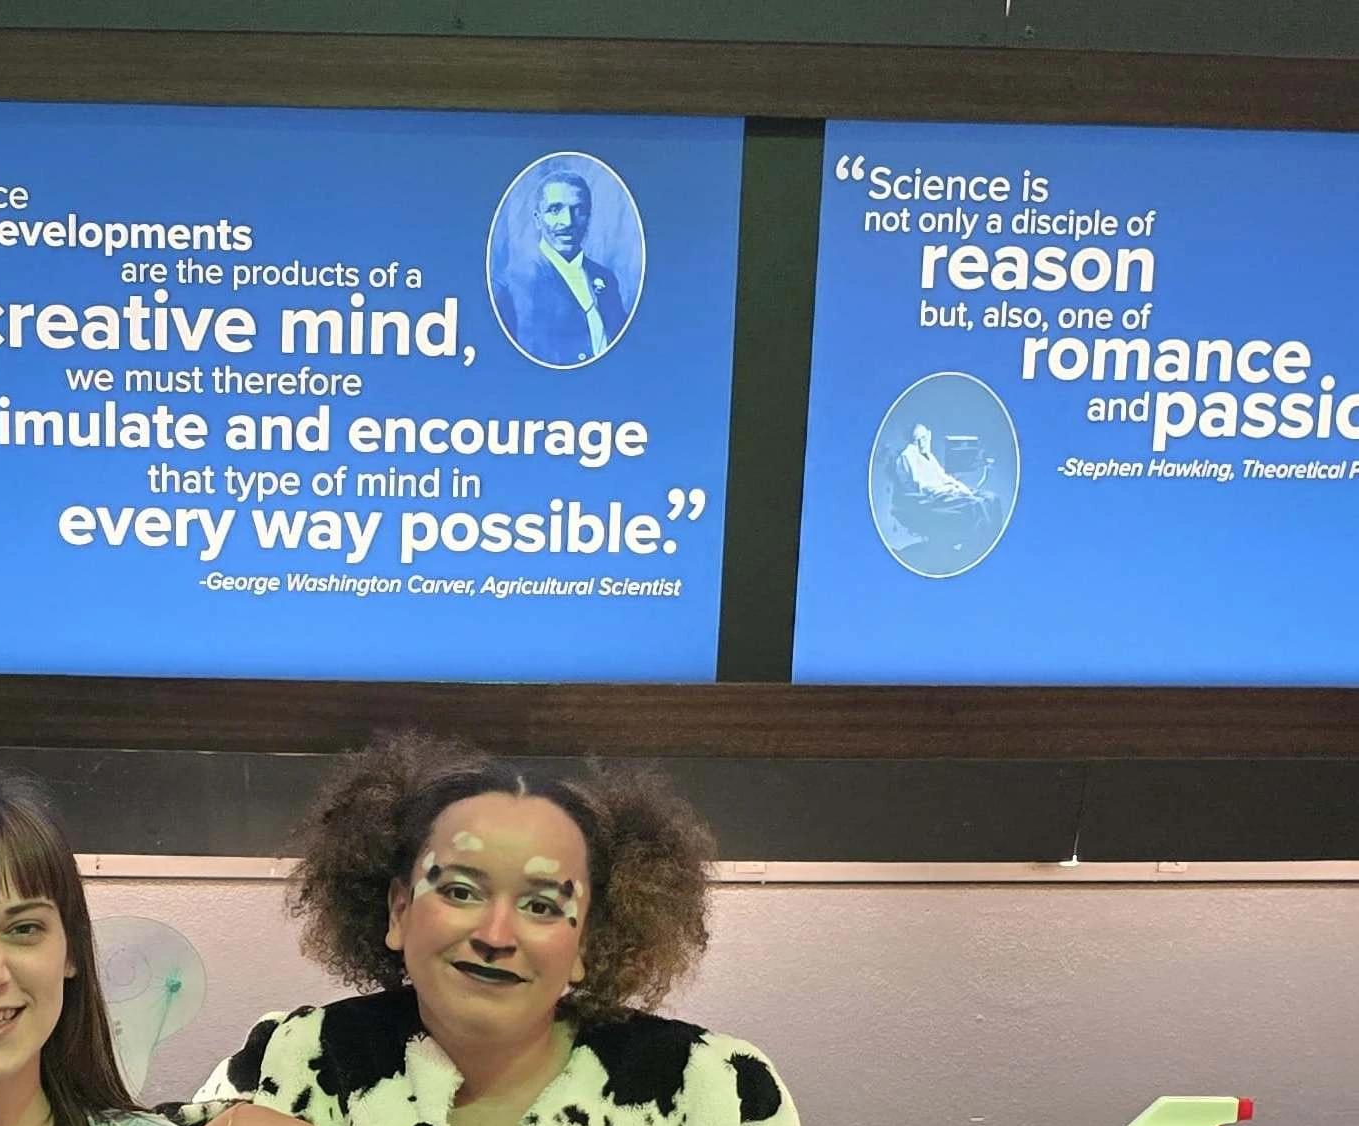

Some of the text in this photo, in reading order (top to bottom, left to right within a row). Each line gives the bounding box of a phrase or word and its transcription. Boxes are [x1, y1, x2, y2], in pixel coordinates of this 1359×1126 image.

[836, 155, 1049, 203] “Science is
[864, 207, 1156, 241] not only a disciple of
[121, 258, 422, 291] are the products of a
[921, 245, 1155, 292] reason
[281, 292, 476, 367] mind,
[920, 299, 1153, 332] but, also, one of
[1022, 337, 1311, 384] romance
[65, 365, 362, 396] we must therefore
[1087, 391, 1150, 422] and
[225, 405, 330, 452] and
[348, 417, 648, 468] encourage
[147, 462, 481, 503] that type of mind in
[1057, 457, 1144, 481] -Stephen
[1147, 459, 1235, 482] Hawking,
[1243, 459, 1347, 479] Theoretical
[58, 488, 706, 564] every way possible.”
[199, 571, 682, 599] -George Washington Carver, Agricultural Scientist
